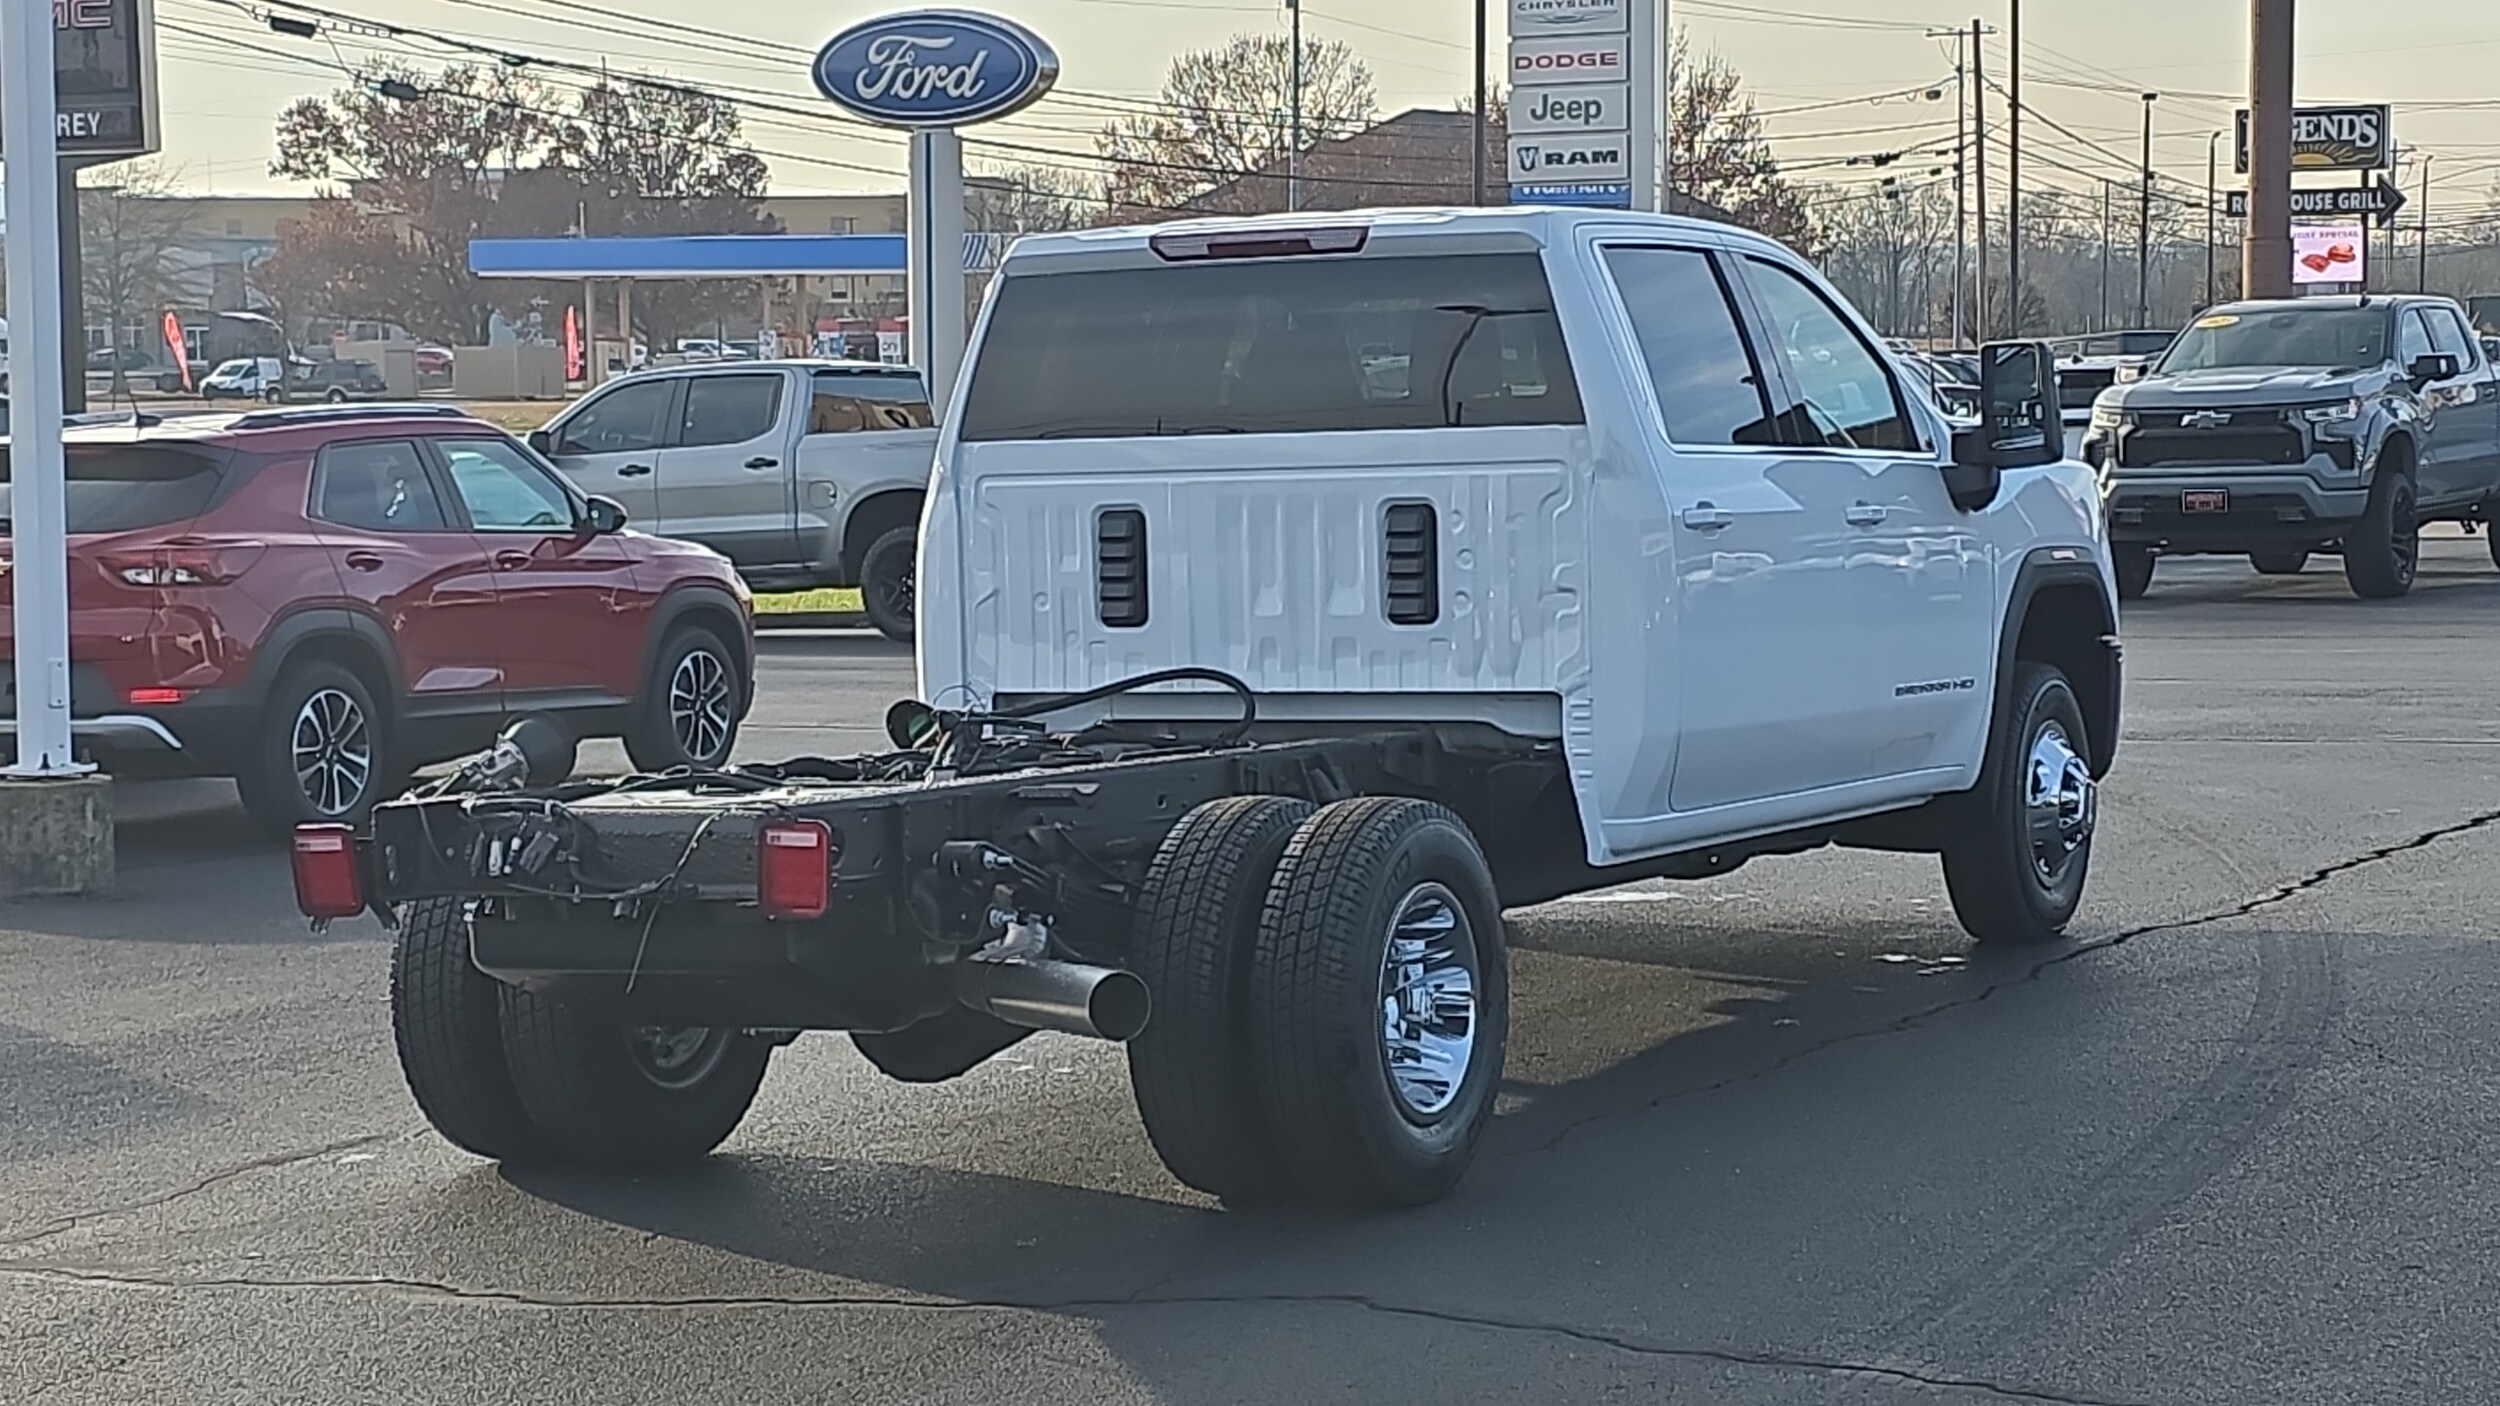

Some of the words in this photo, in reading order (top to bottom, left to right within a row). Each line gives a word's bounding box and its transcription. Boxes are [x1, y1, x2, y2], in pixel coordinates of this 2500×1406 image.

[855, 35, 988, 99] Ford
[1515, 52, 1618, 70] DODGE
[1530, 94, 1602, 125] Jeep
[1544, 150, 1618, 165] RAM
[2338, 191, 2386, 210] GRILL
